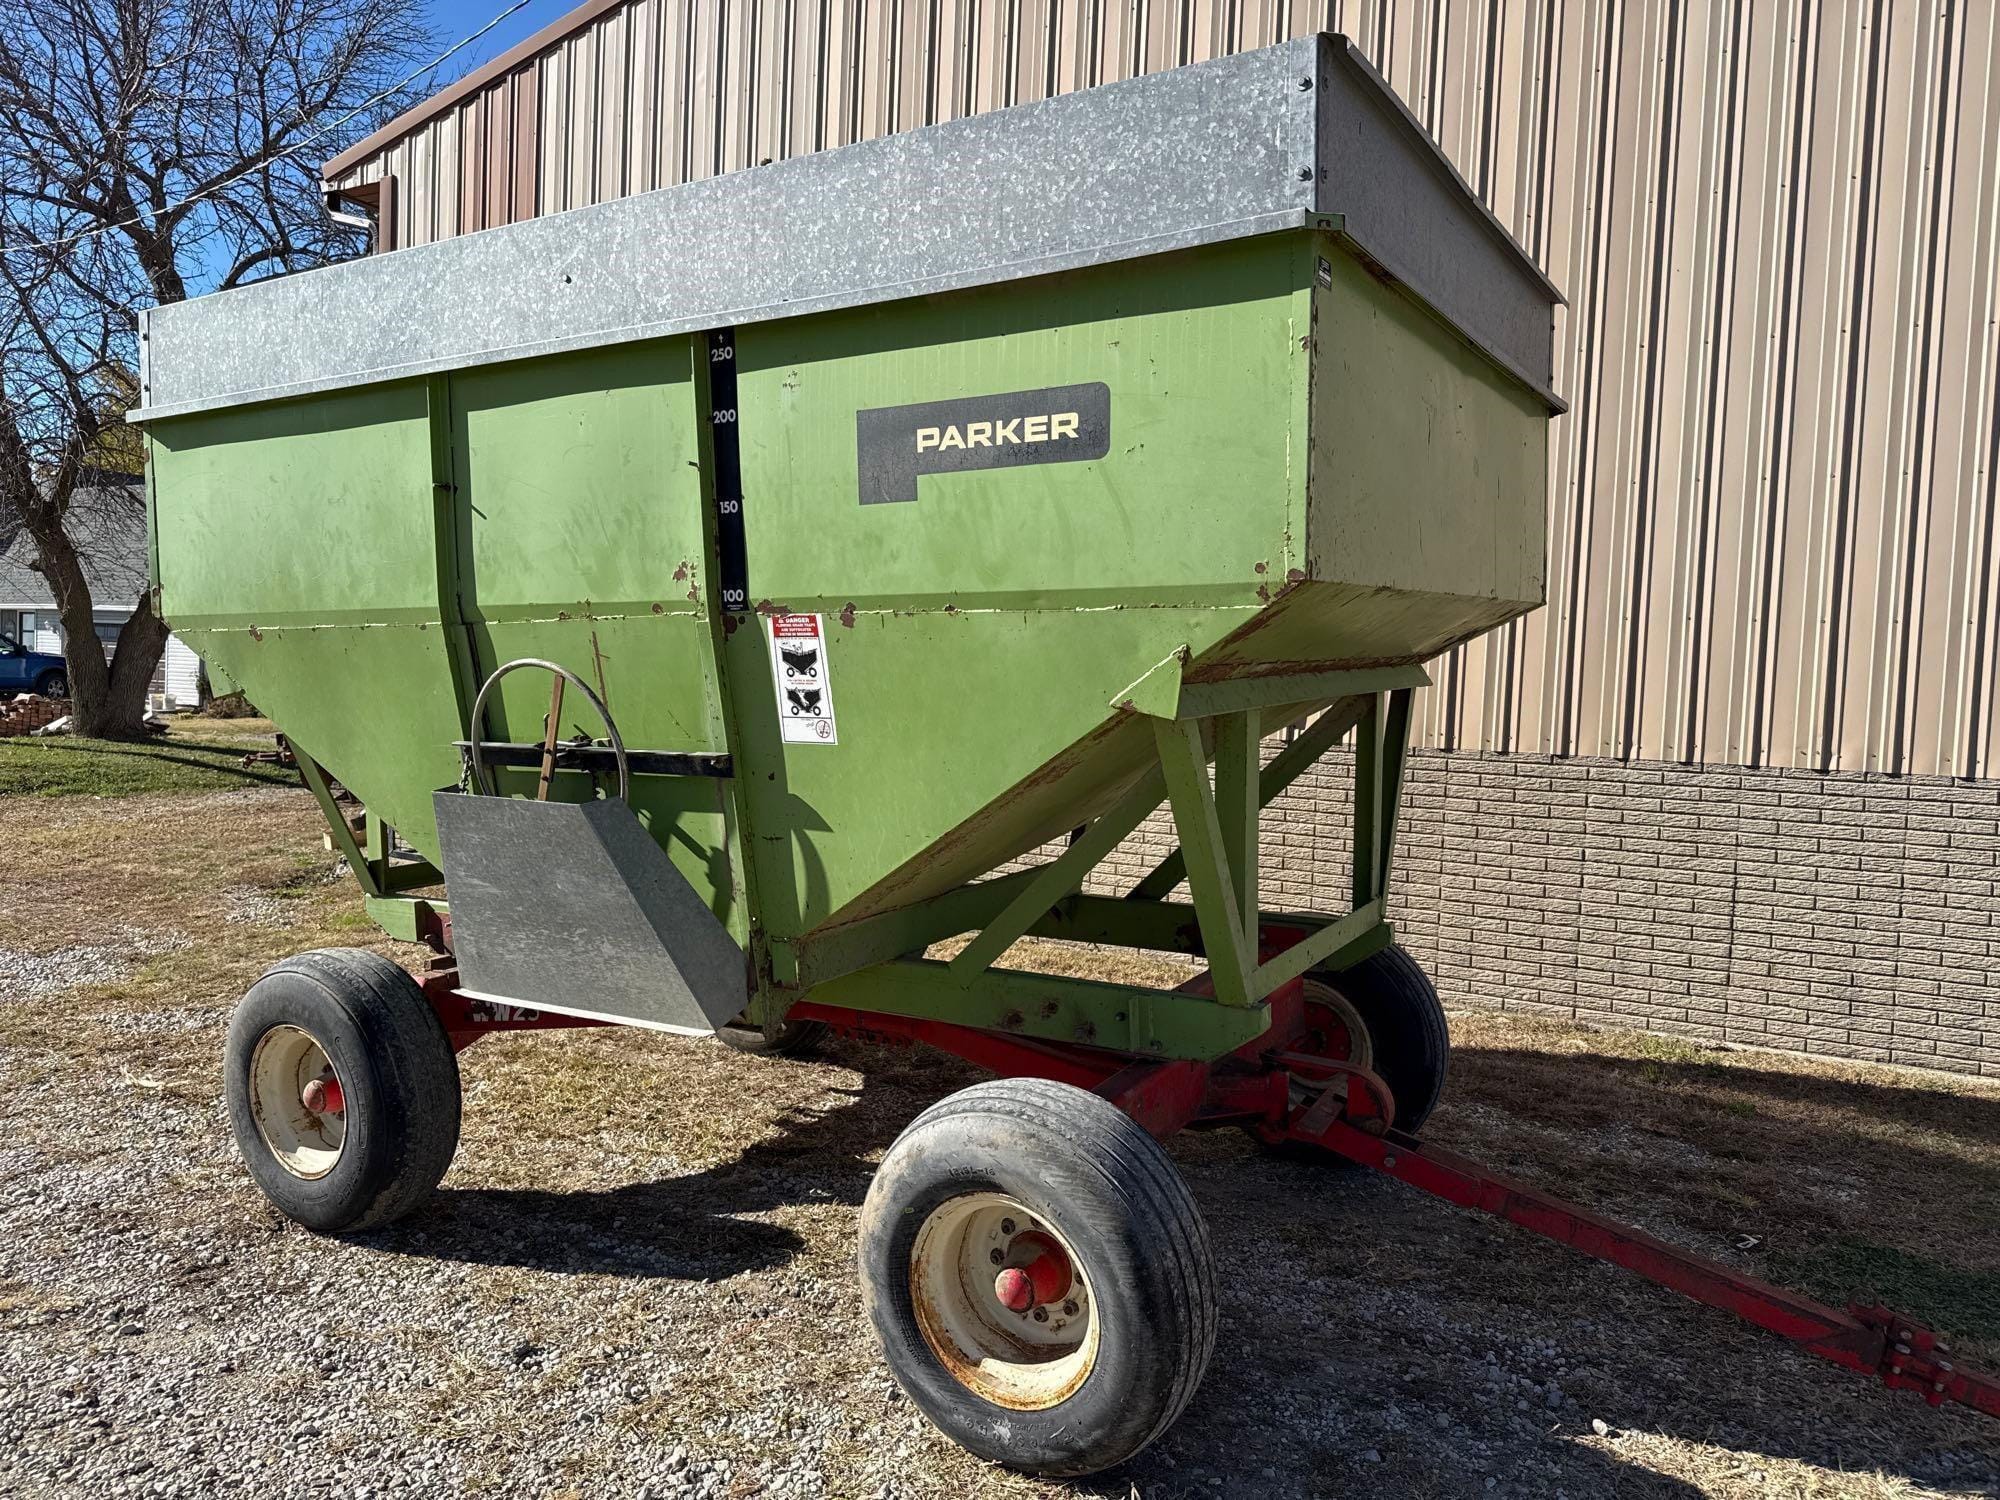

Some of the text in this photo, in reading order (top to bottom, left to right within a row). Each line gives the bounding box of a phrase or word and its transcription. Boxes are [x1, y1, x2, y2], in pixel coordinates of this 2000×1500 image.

[711, 346, 733, 362] 250
[713, 408, 736, 424] 200
[916, 412, 1079, 454] PARKER
[720, 500, 739, 514] 150
[723, 589, 744, 602] 100
